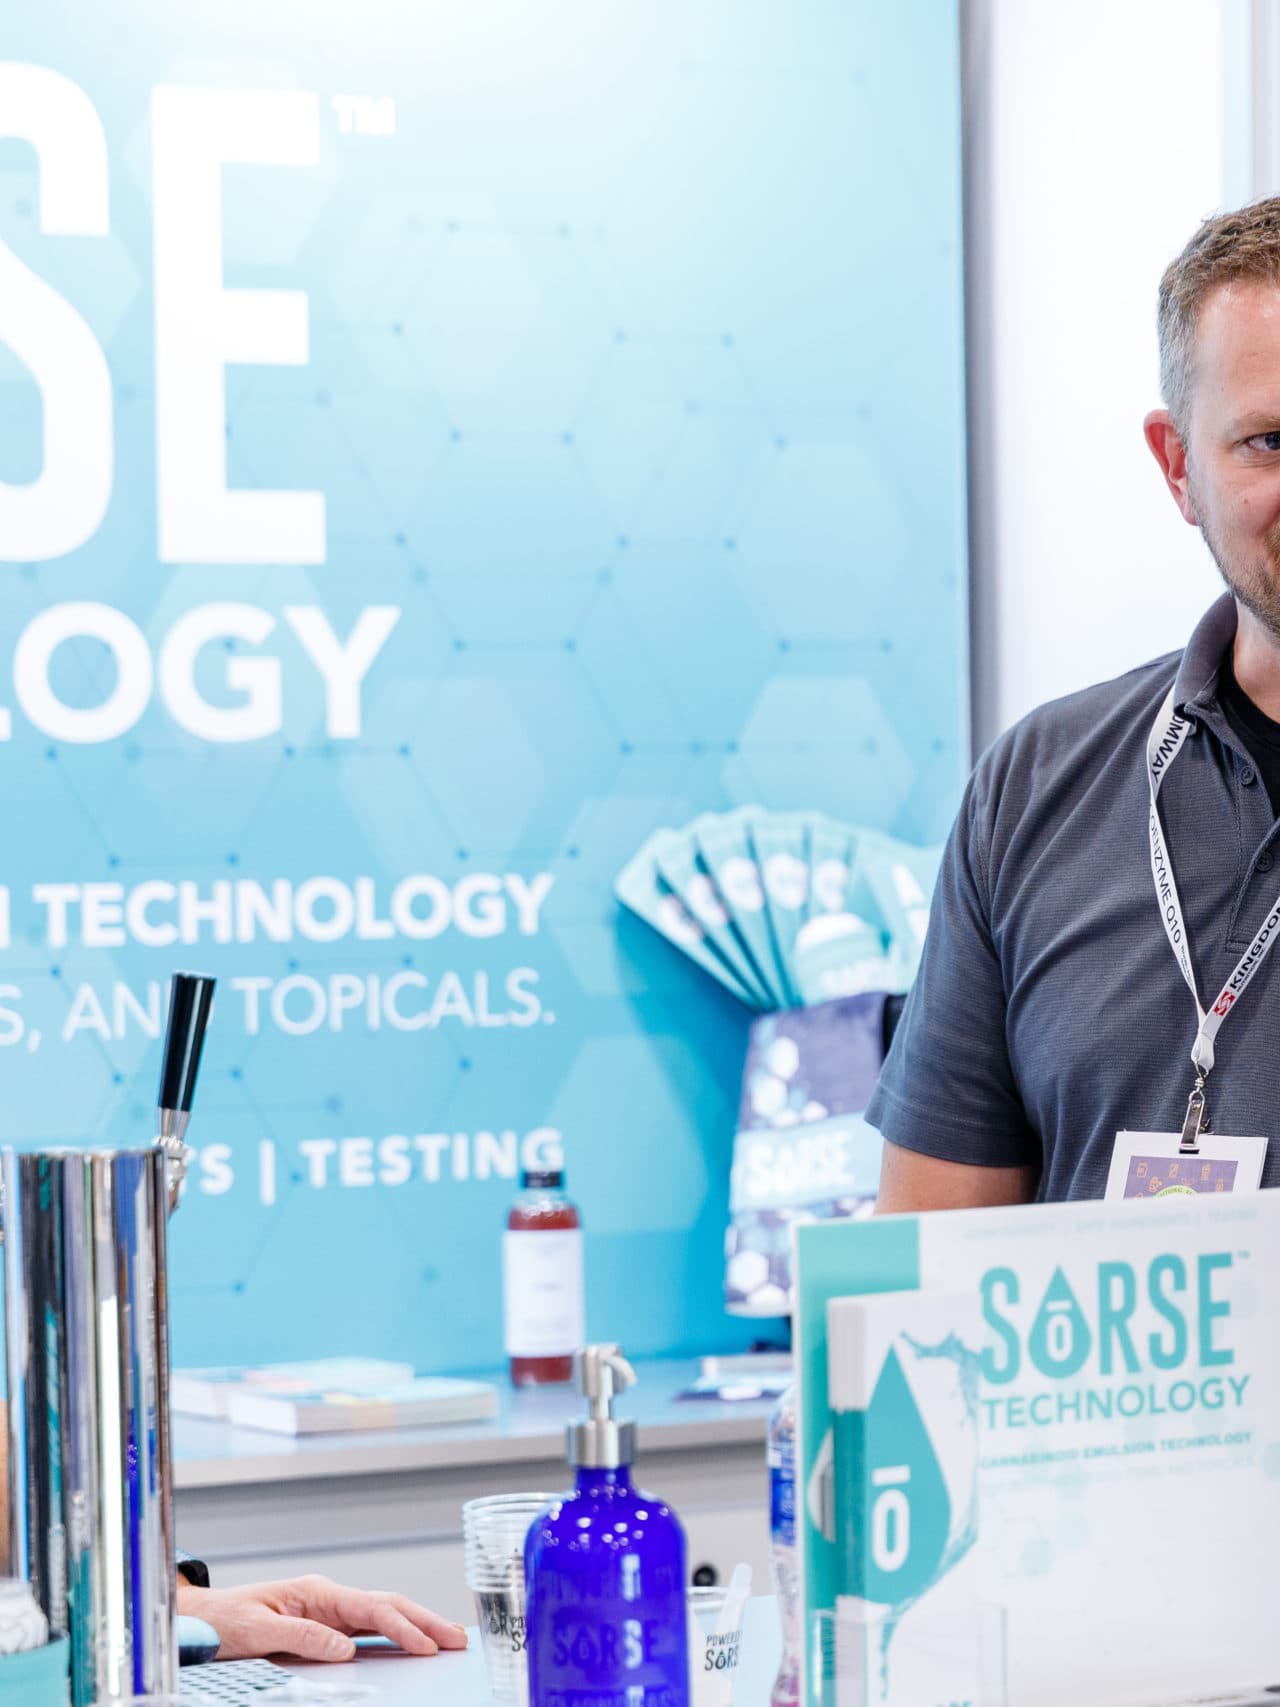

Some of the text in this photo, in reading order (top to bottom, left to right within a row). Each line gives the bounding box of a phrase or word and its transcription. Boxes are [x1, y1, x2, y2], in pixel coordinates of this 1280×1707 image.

[0, 600, 402, 745] OGY
[32, 872, 556, 949] TECHNOLOGY
[1165, 904, 1182, 943] Q10
[61, 975, 172, 1043] AN
[230, 966, 557, 1036] TOPICALS.
[300, 1127, 565, 1190] TESTING
[981, 1374, 1253, 1431] TECHNOLOGY
[1159, 1430, 1254, 1451] TECHNOLOGY
